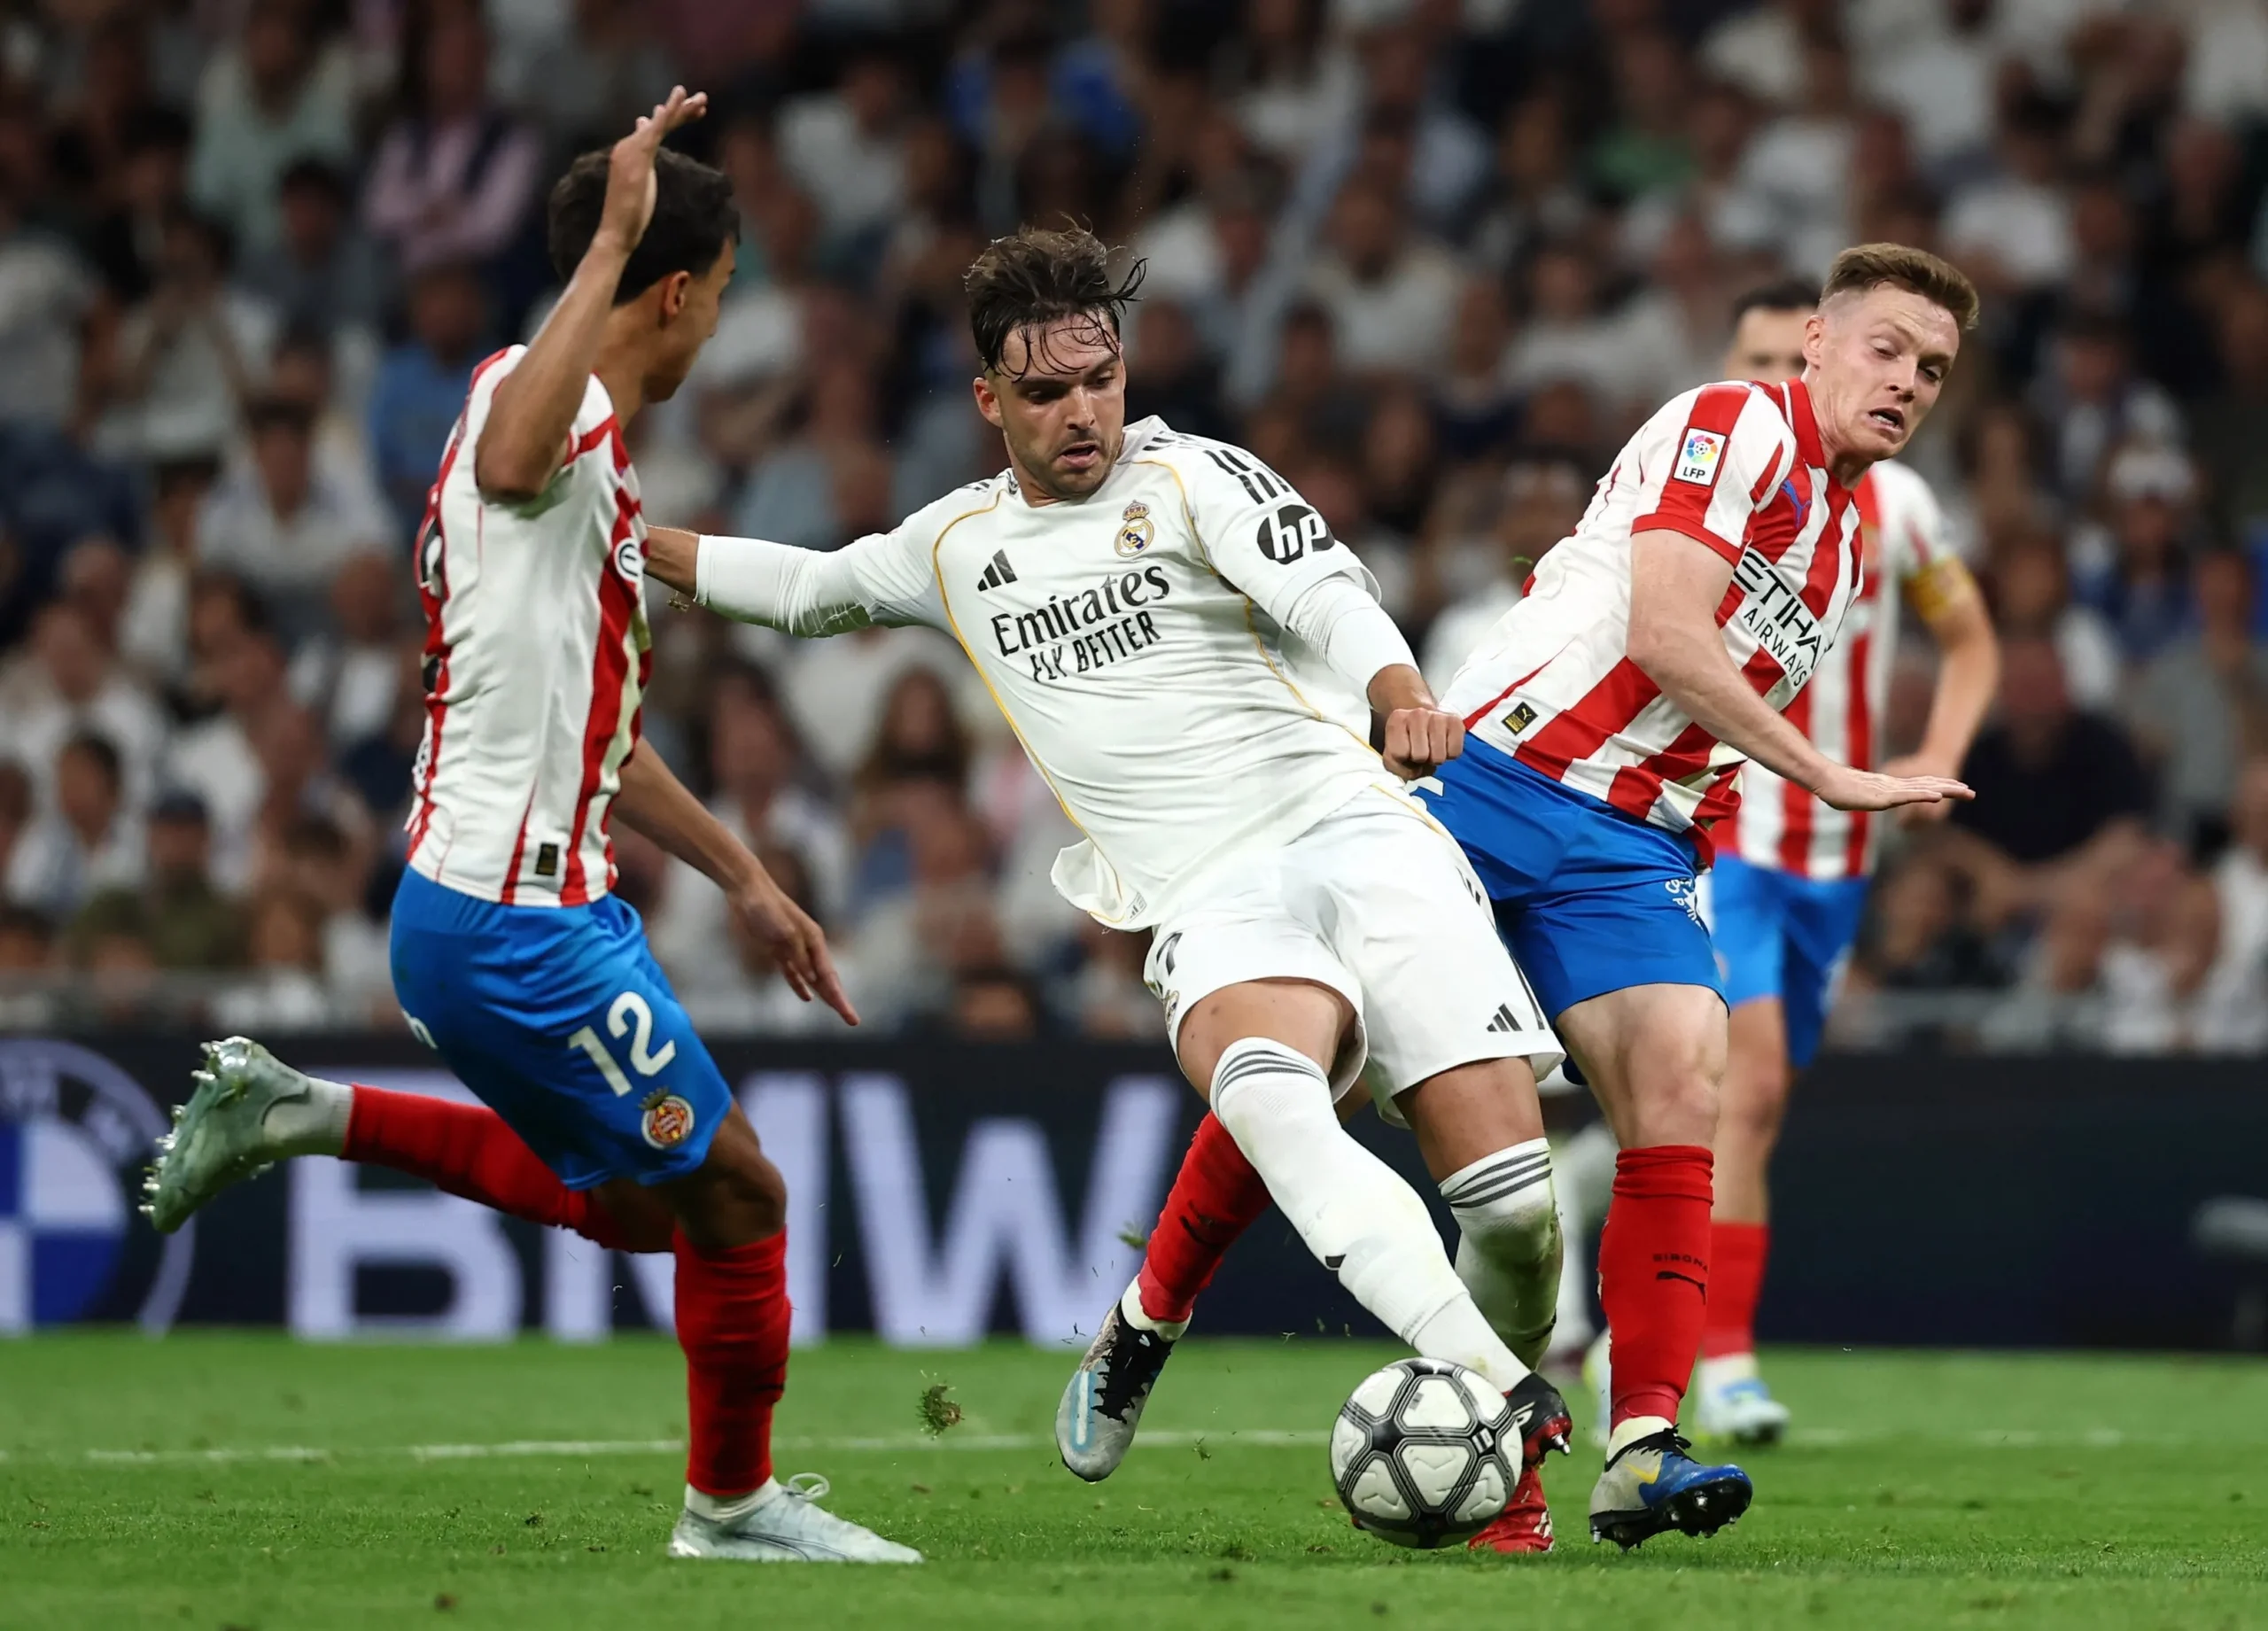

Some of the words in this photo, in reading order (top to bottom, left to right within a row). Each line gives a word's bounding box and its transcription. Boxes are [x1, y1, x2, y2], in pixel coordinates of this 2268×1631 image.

[1682, 466, 1706, 479] LFP
[1263, 505, 1332, 564] hp
[990, 565, 1170, 657] Emirates
[1072, 610, 1161, 673] BETTER
[1733, 550, 1833, 671] ETIHA
[1743, 607, 1807, 687] AIRWAYS
[567, 990, 677, 1098] 12
